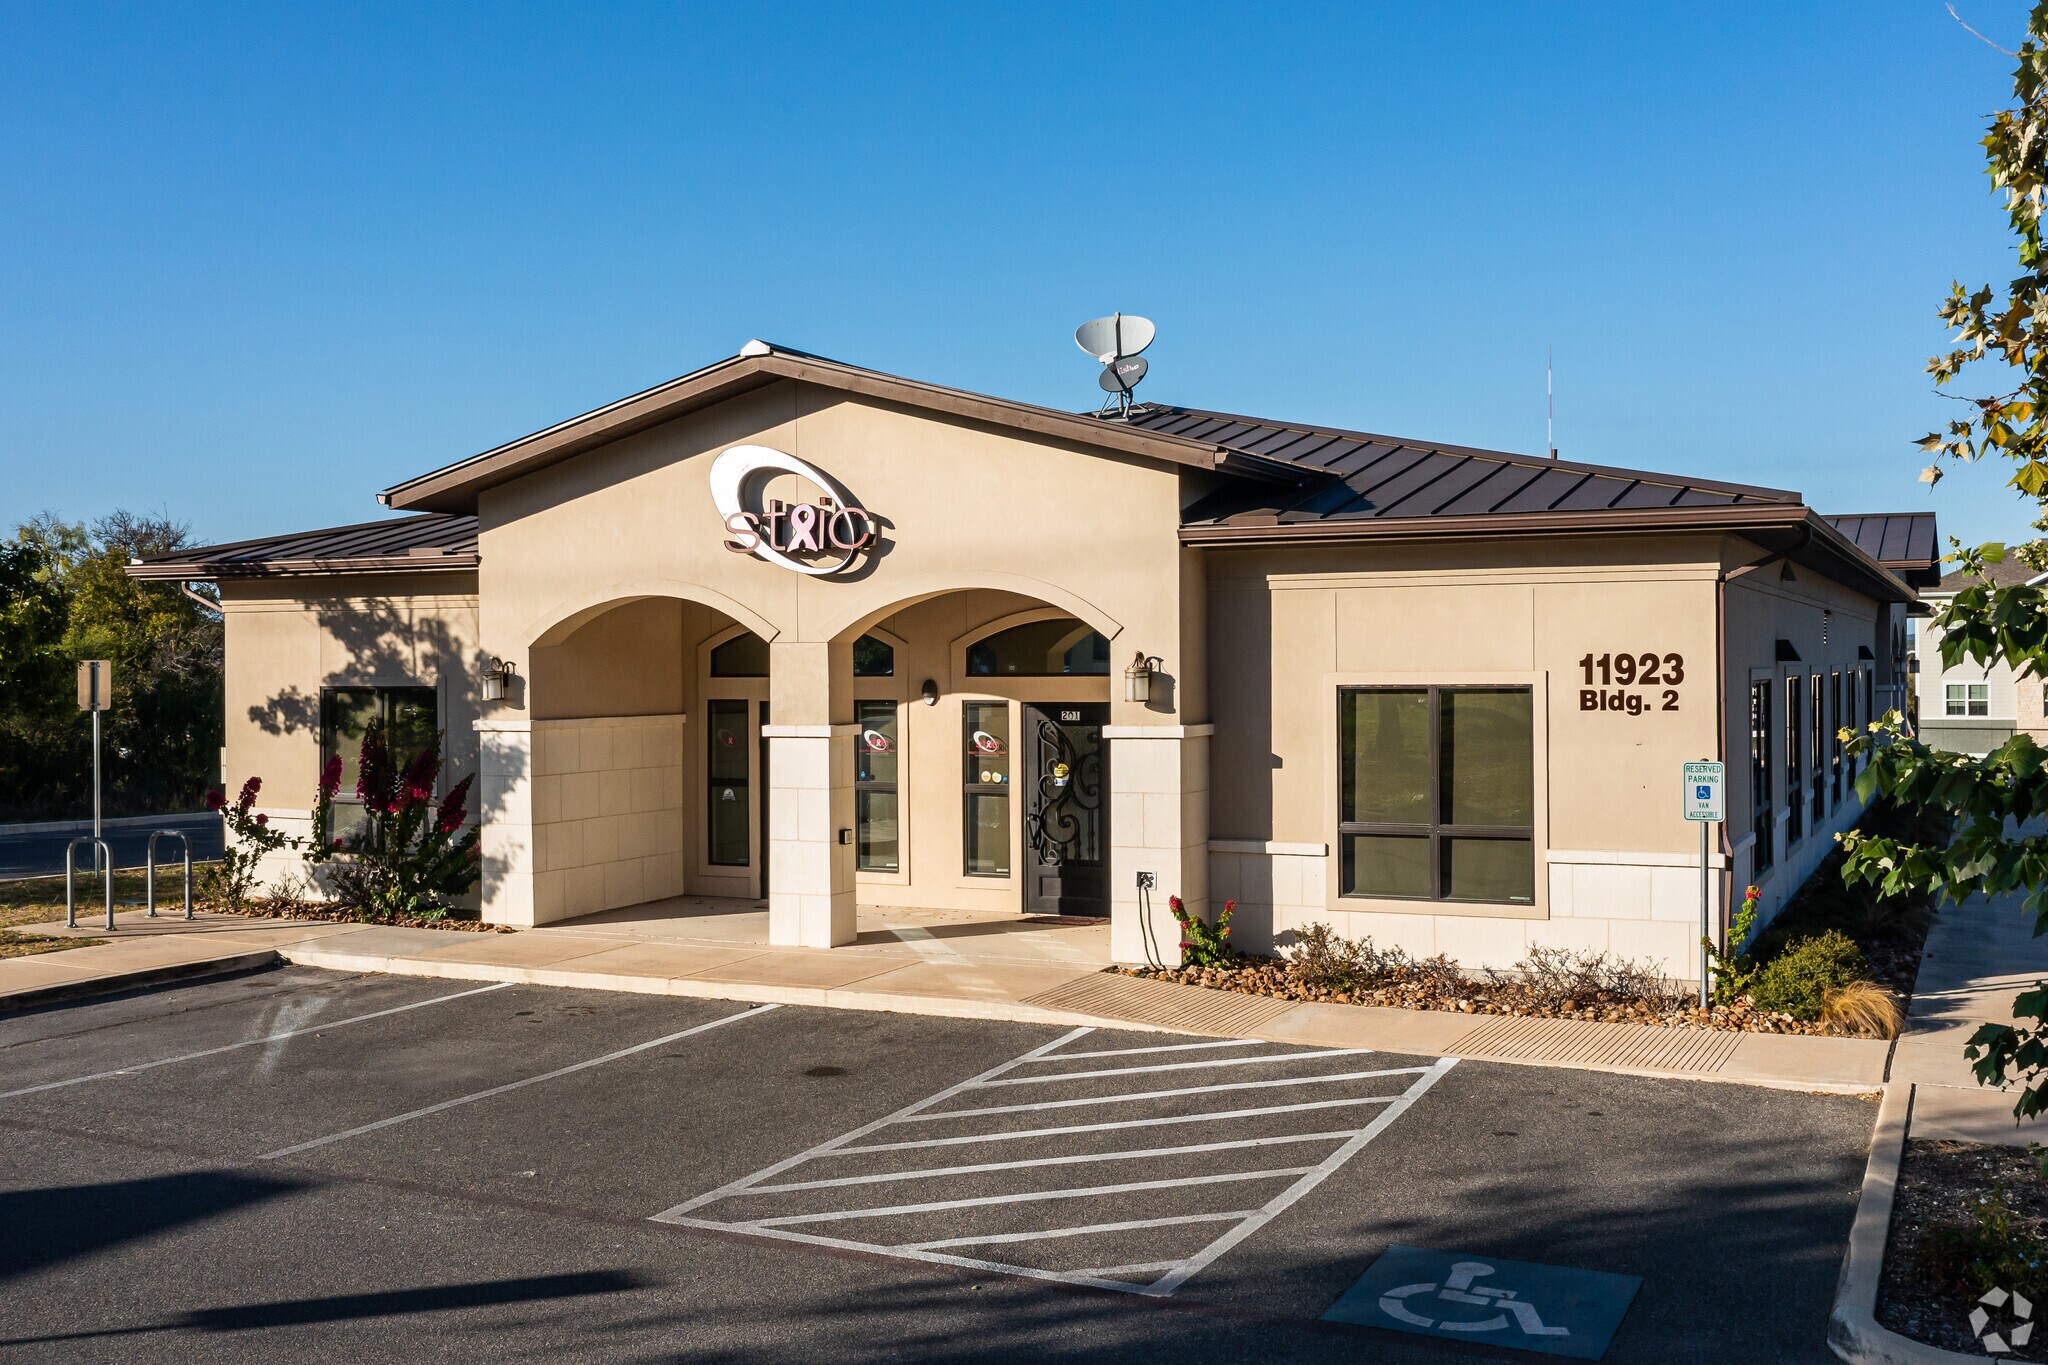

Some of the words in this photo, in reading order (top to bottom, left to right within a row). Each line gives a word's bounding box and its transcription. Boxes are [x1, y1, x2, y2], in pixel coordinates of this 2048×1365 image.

[1579, 652, 1685, 686] 11923
[1579, 689, 1651, 716] Bldg.
[1661, 689, 1679, 711] 2
[1062, 711, 1079, 720] 201
[1685, 765, 1721, 773] RESERVED
[1688, 775, 1719, 783] PARKING
